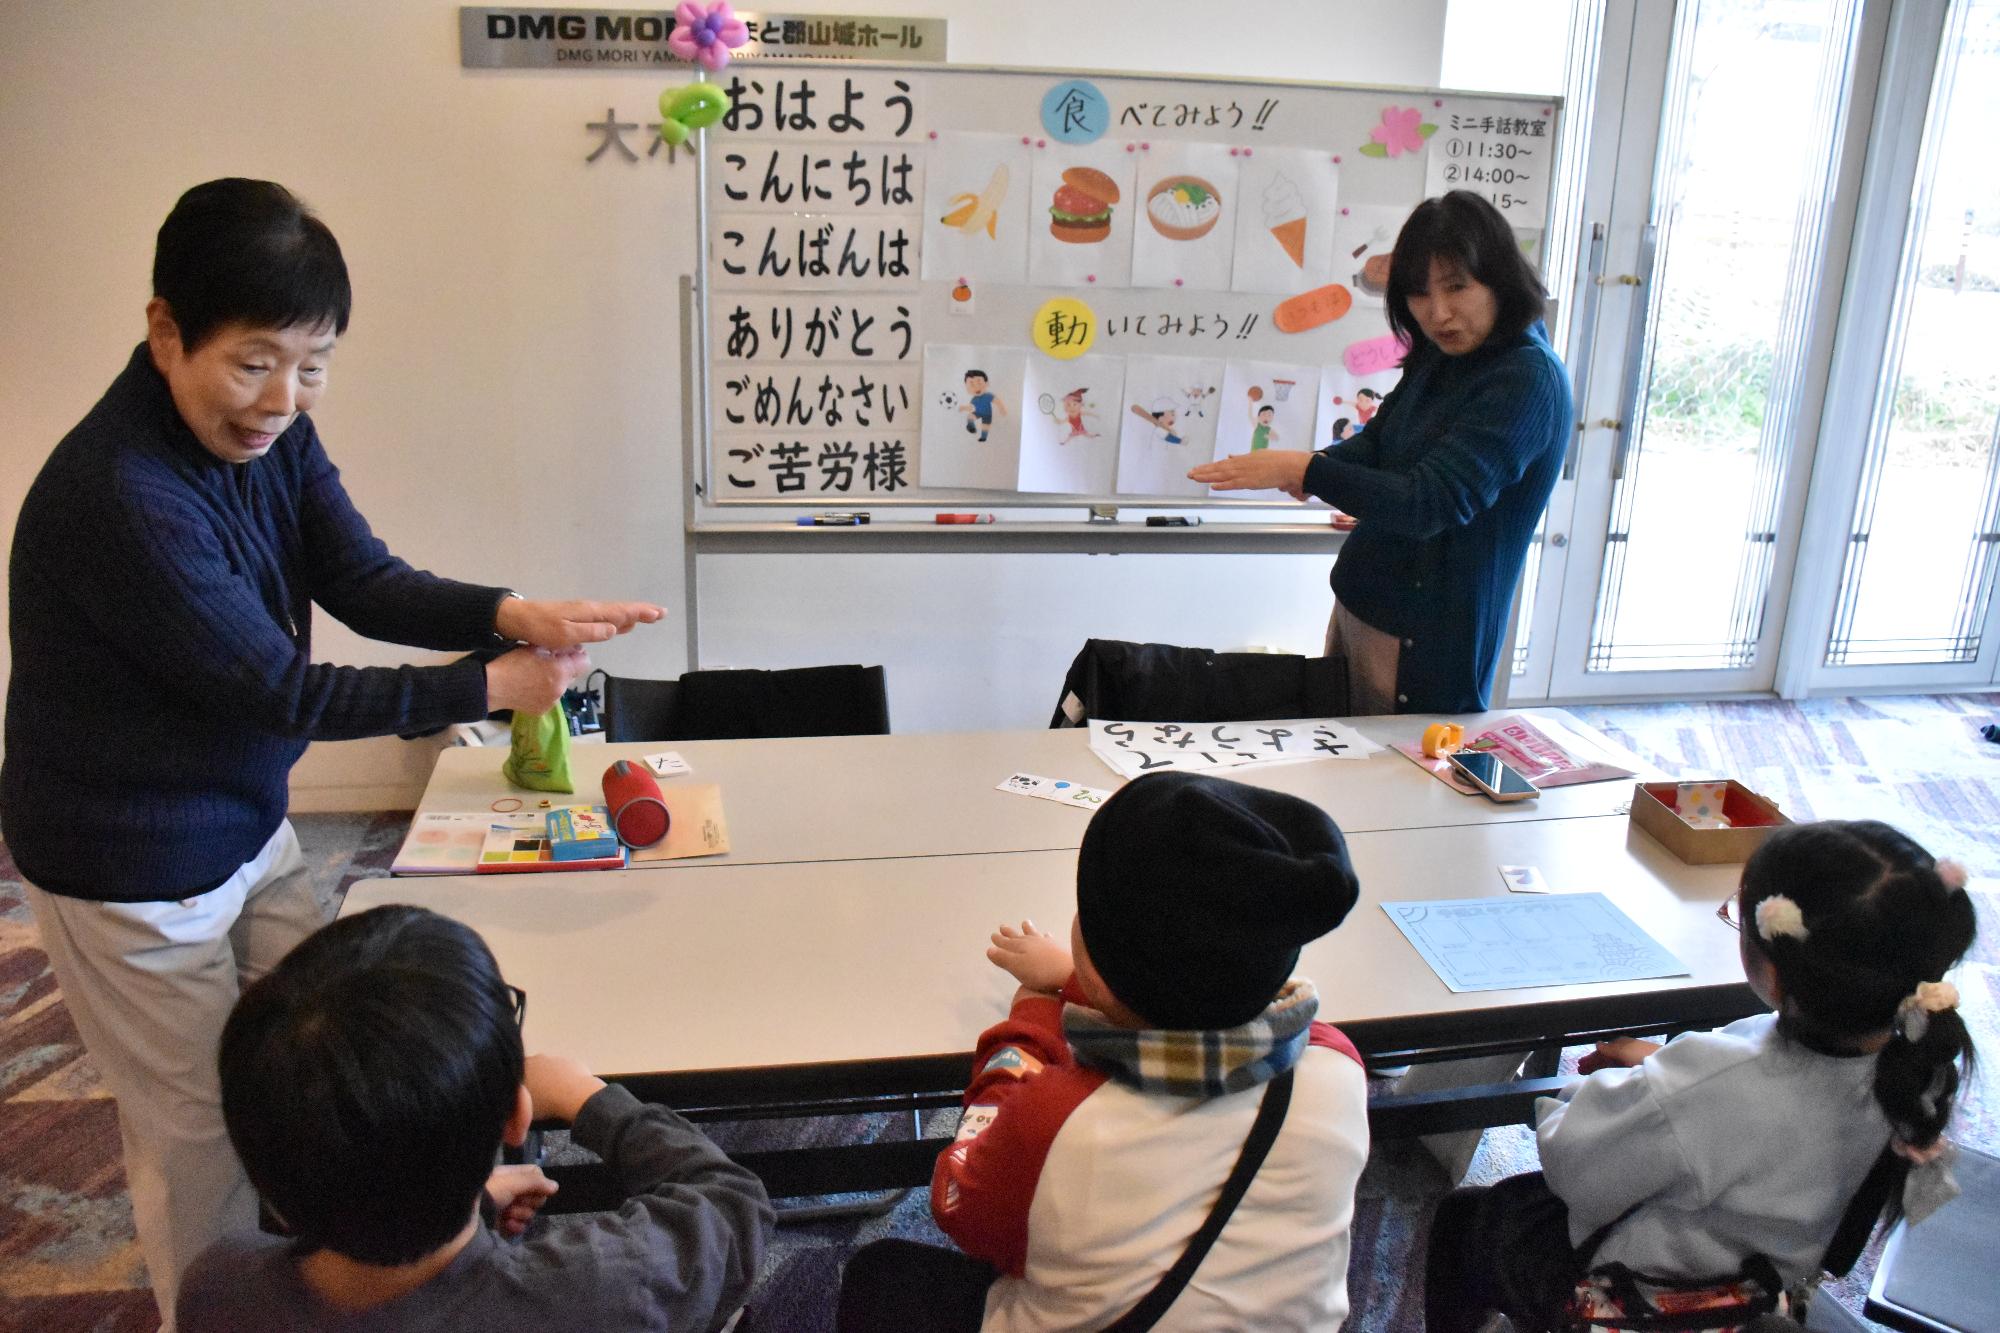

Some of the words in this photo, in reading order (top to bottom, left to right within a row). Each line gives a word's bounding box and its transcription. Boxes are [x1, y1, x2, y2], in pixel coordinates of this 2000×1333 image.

[487, 14, 586, 40] DMG
[557, 48, 593, 62] DMG
[601, 49, 638, 62] MORI
[722, 77, 913, 137] おはよう
[1450, 114, 1547, 137] ミニ手話教室
[724, 150, 913, 206] こんにちは
[723, 222, 909, 277] こんばんは
[727, 305, 912, 360] ありがとう
[726, 374, 908, 426] ごめんなさい
[728, 440, 908, 493] ご苦労様
[1103, 723, 1349, 755] さようなら
